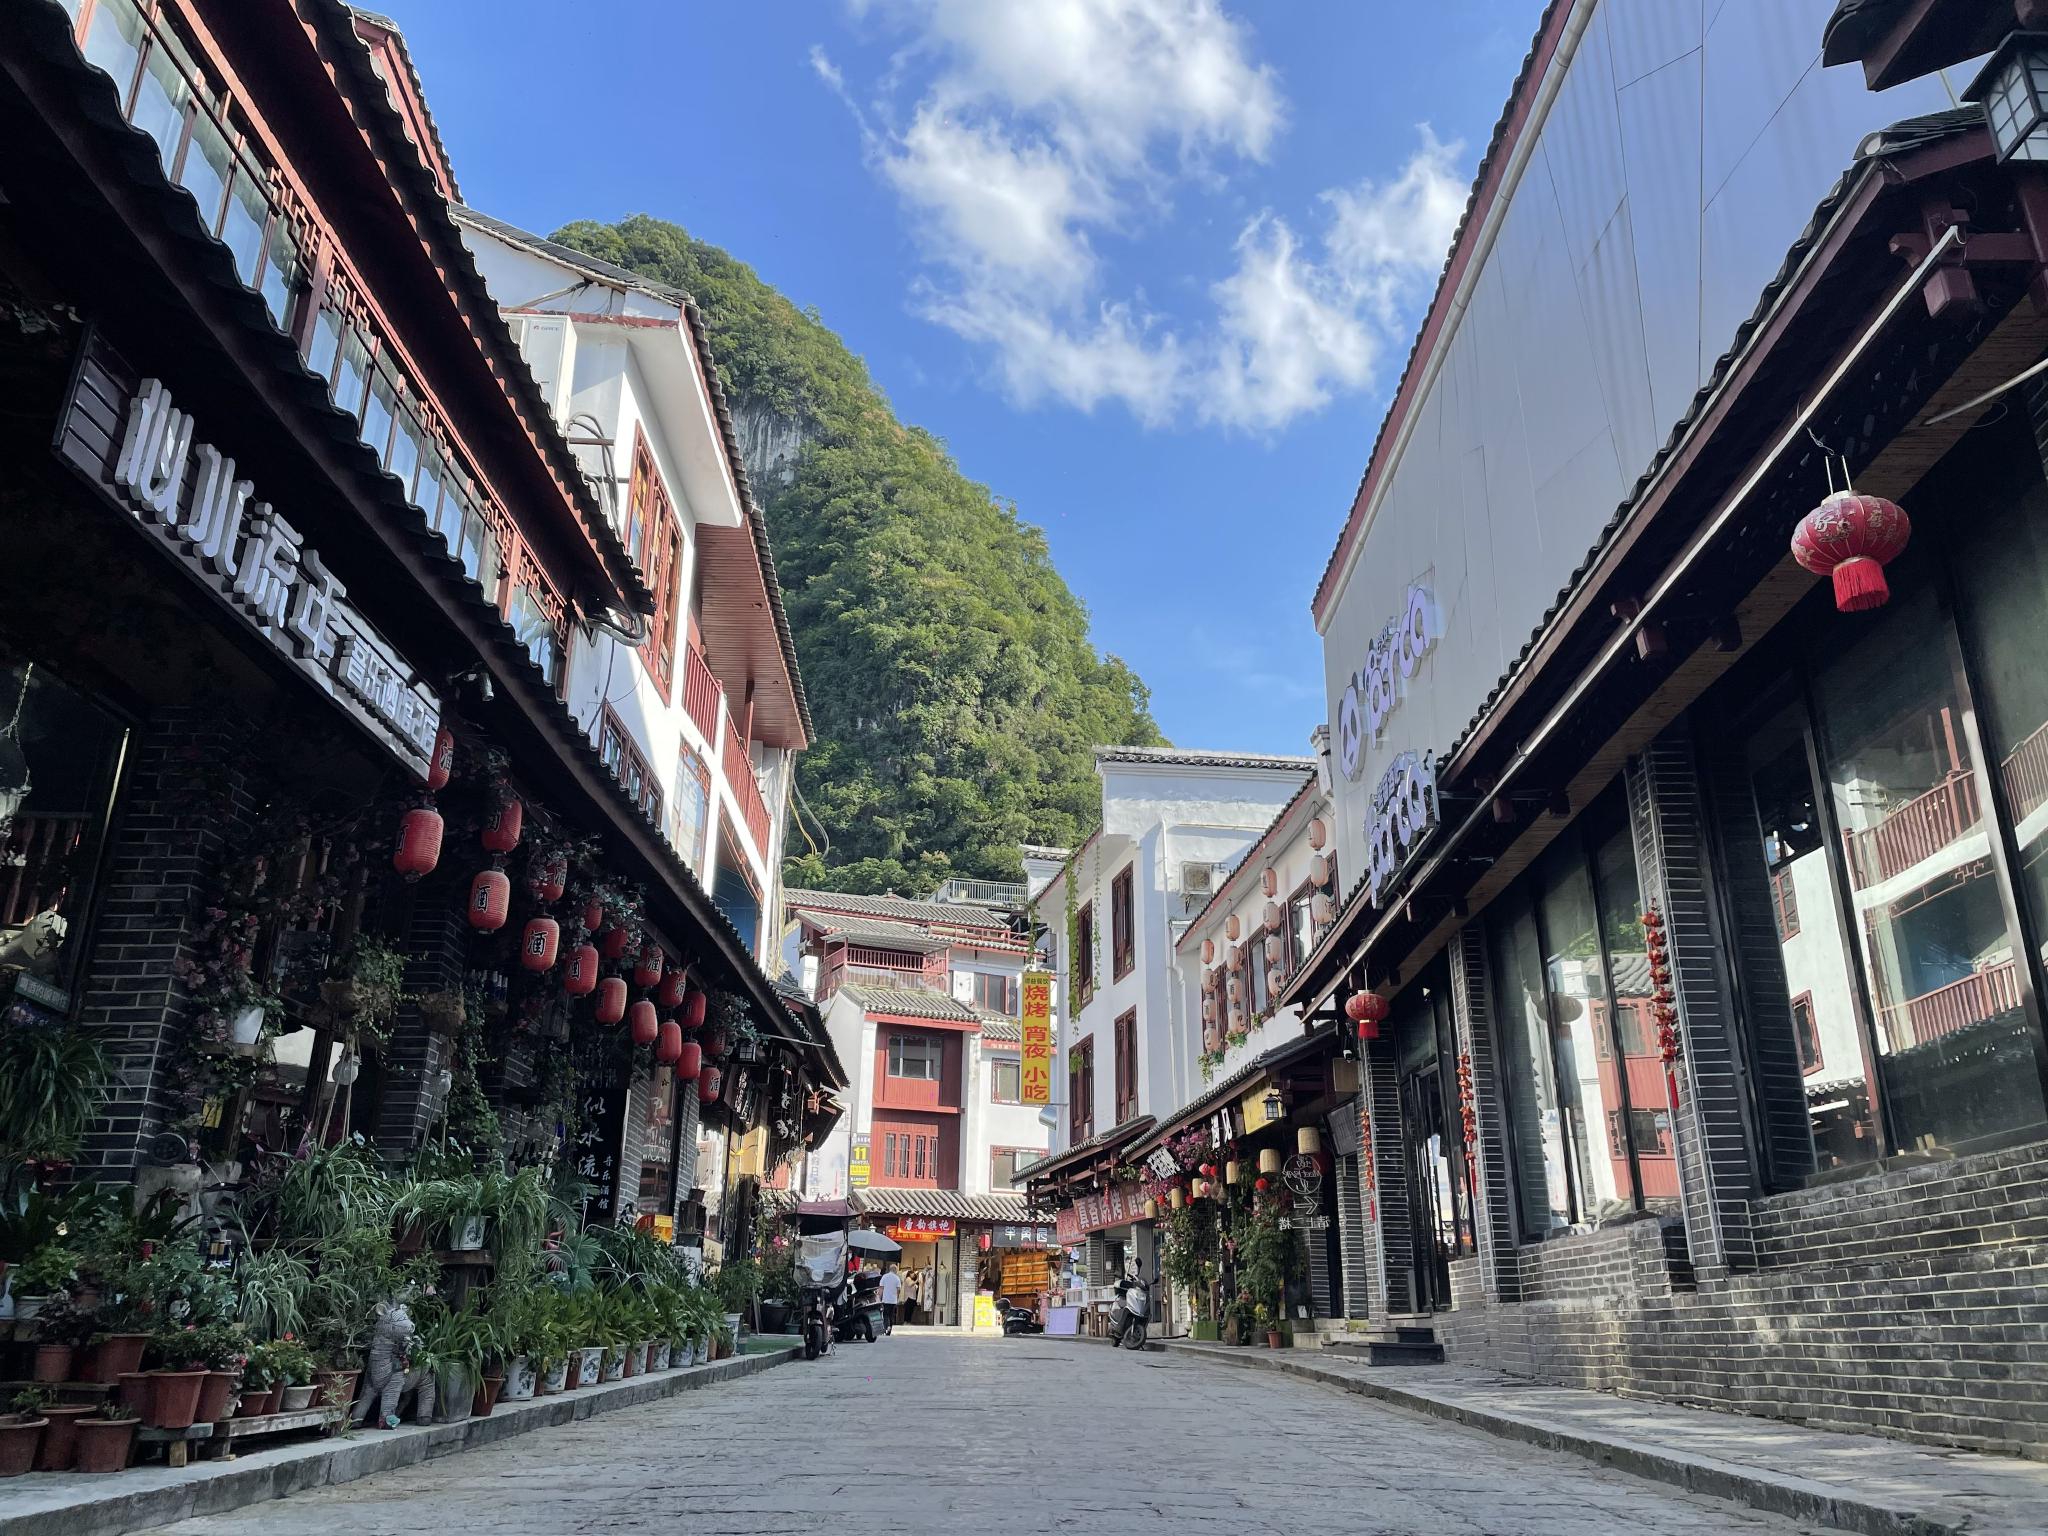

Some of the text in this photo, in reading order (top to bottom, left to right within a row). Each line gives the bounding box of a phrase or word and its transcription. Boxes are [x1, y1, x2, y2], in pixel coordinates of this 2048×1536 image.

[528, 930, 549, 957] 酒
[1024, 985, 1049, 1101] 烧烤 宵夜 小吃
